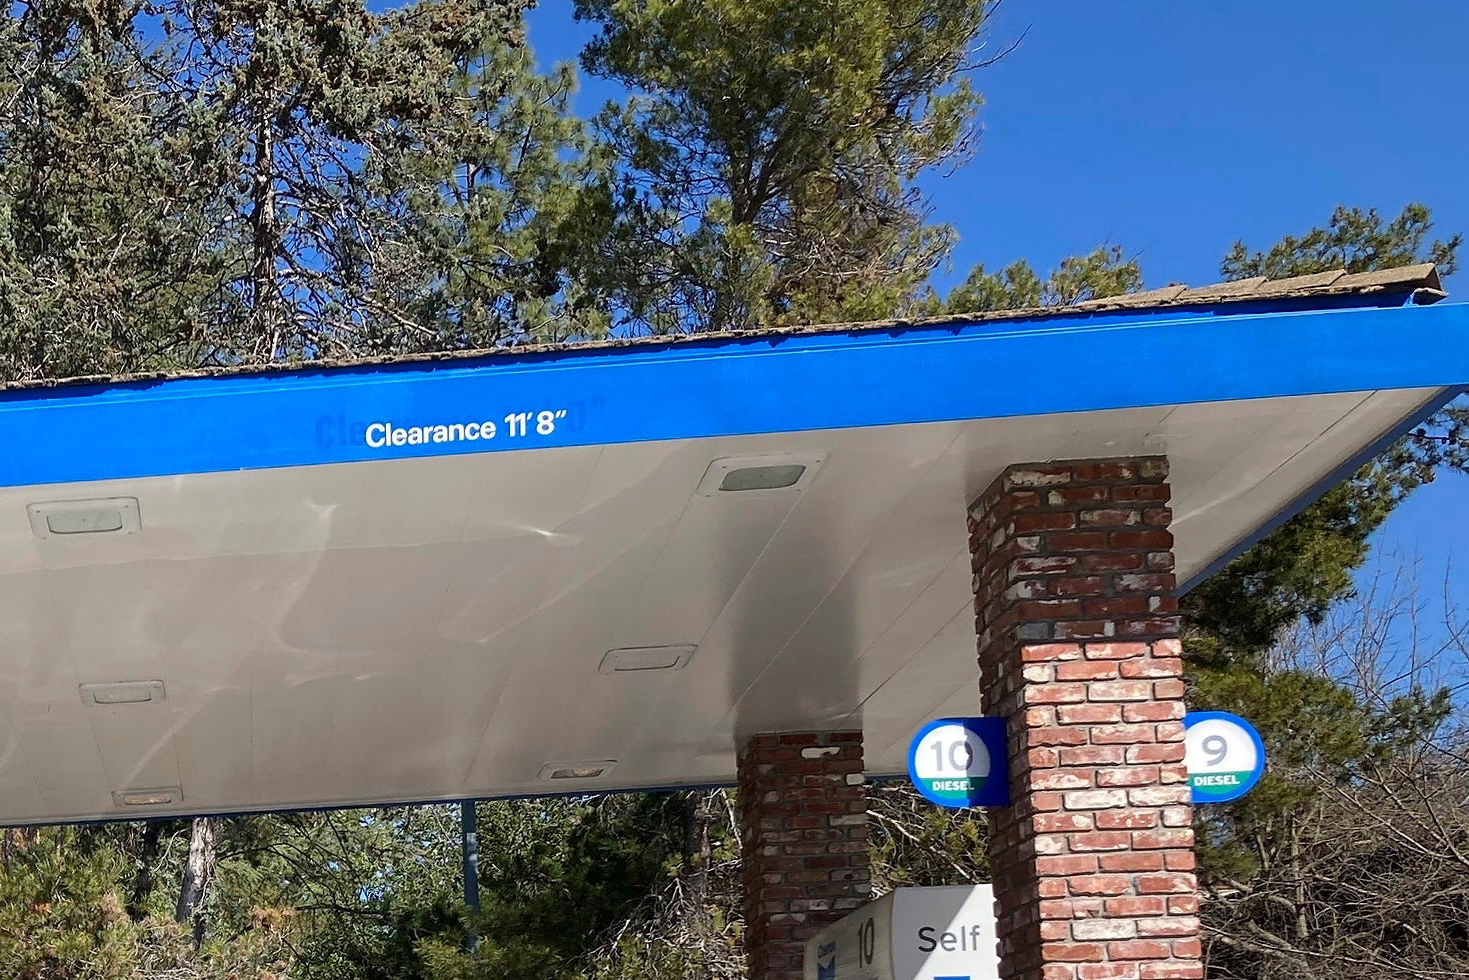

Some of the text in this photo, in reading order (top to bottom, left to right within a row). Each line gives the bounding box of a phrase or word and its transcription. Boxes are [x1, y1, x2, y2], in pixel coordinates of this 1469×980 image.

[365, 419, 497, 449] Clearance
[930, 740, 974, 772] 10
[1201, 734, 1229, 767] 9
[931, 779, 975, 793] DIESEL
[1193, 774, 1241, 787] DIESEL
[857, 916, 875, 969] 10
[917, 924, 981, 953] Self
